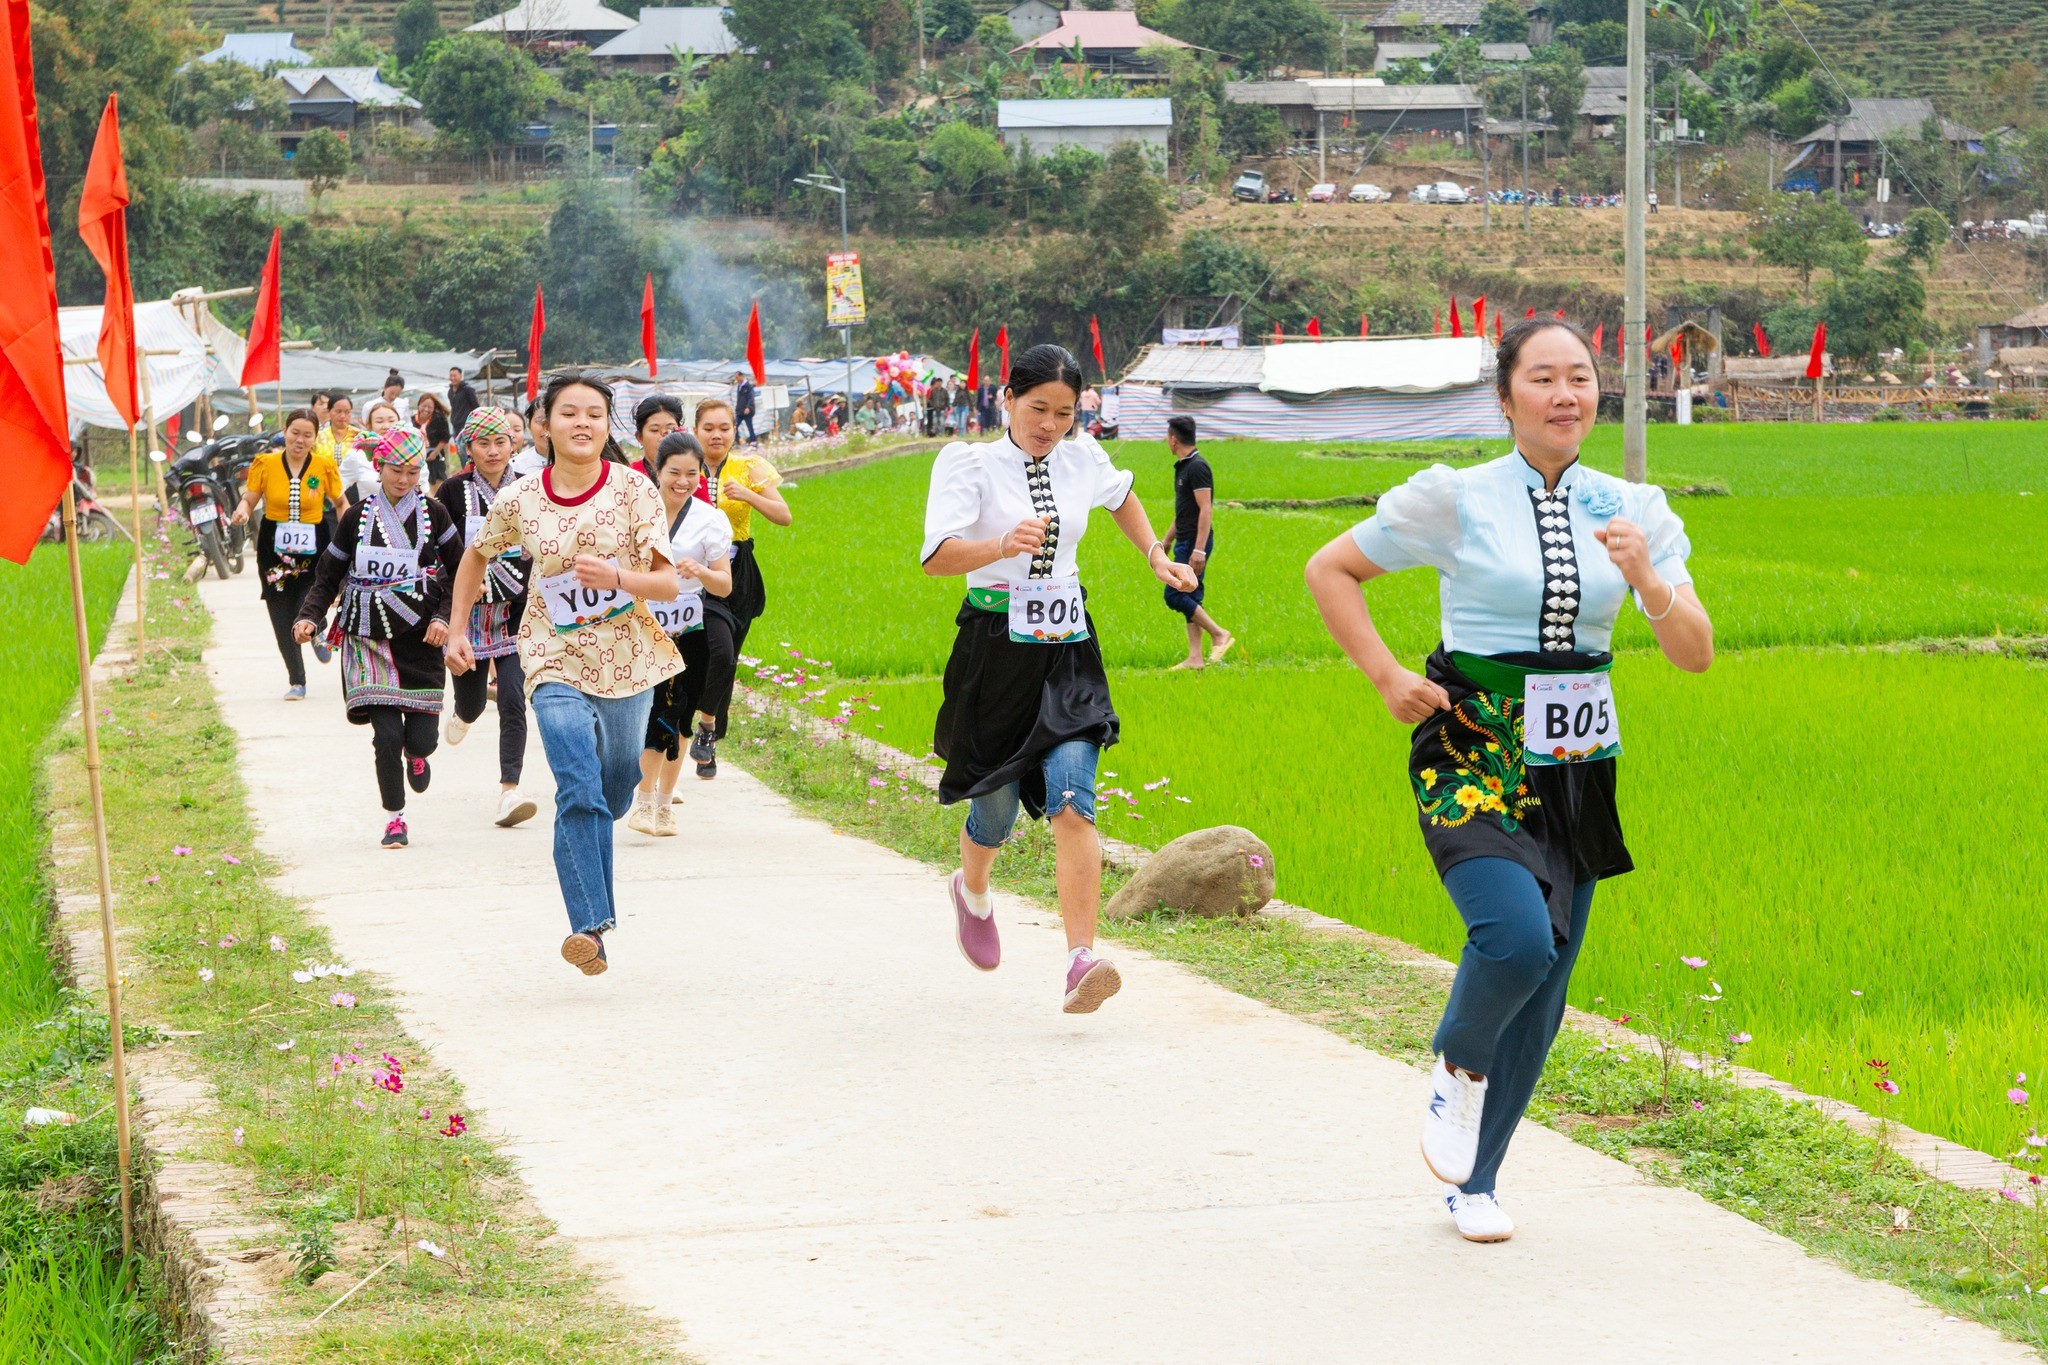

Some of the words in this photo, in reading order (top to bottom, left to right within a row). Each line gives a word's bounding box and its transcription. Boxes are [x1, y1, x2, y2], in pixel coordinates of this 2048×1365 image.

[283, 532, 309, 546] D12
[368, 560, 408, 578] R04
[655, 606, 694, 627] D10
[1027, 597, 1079, 625] B06
[1546, 698, 1609, 740] B05
